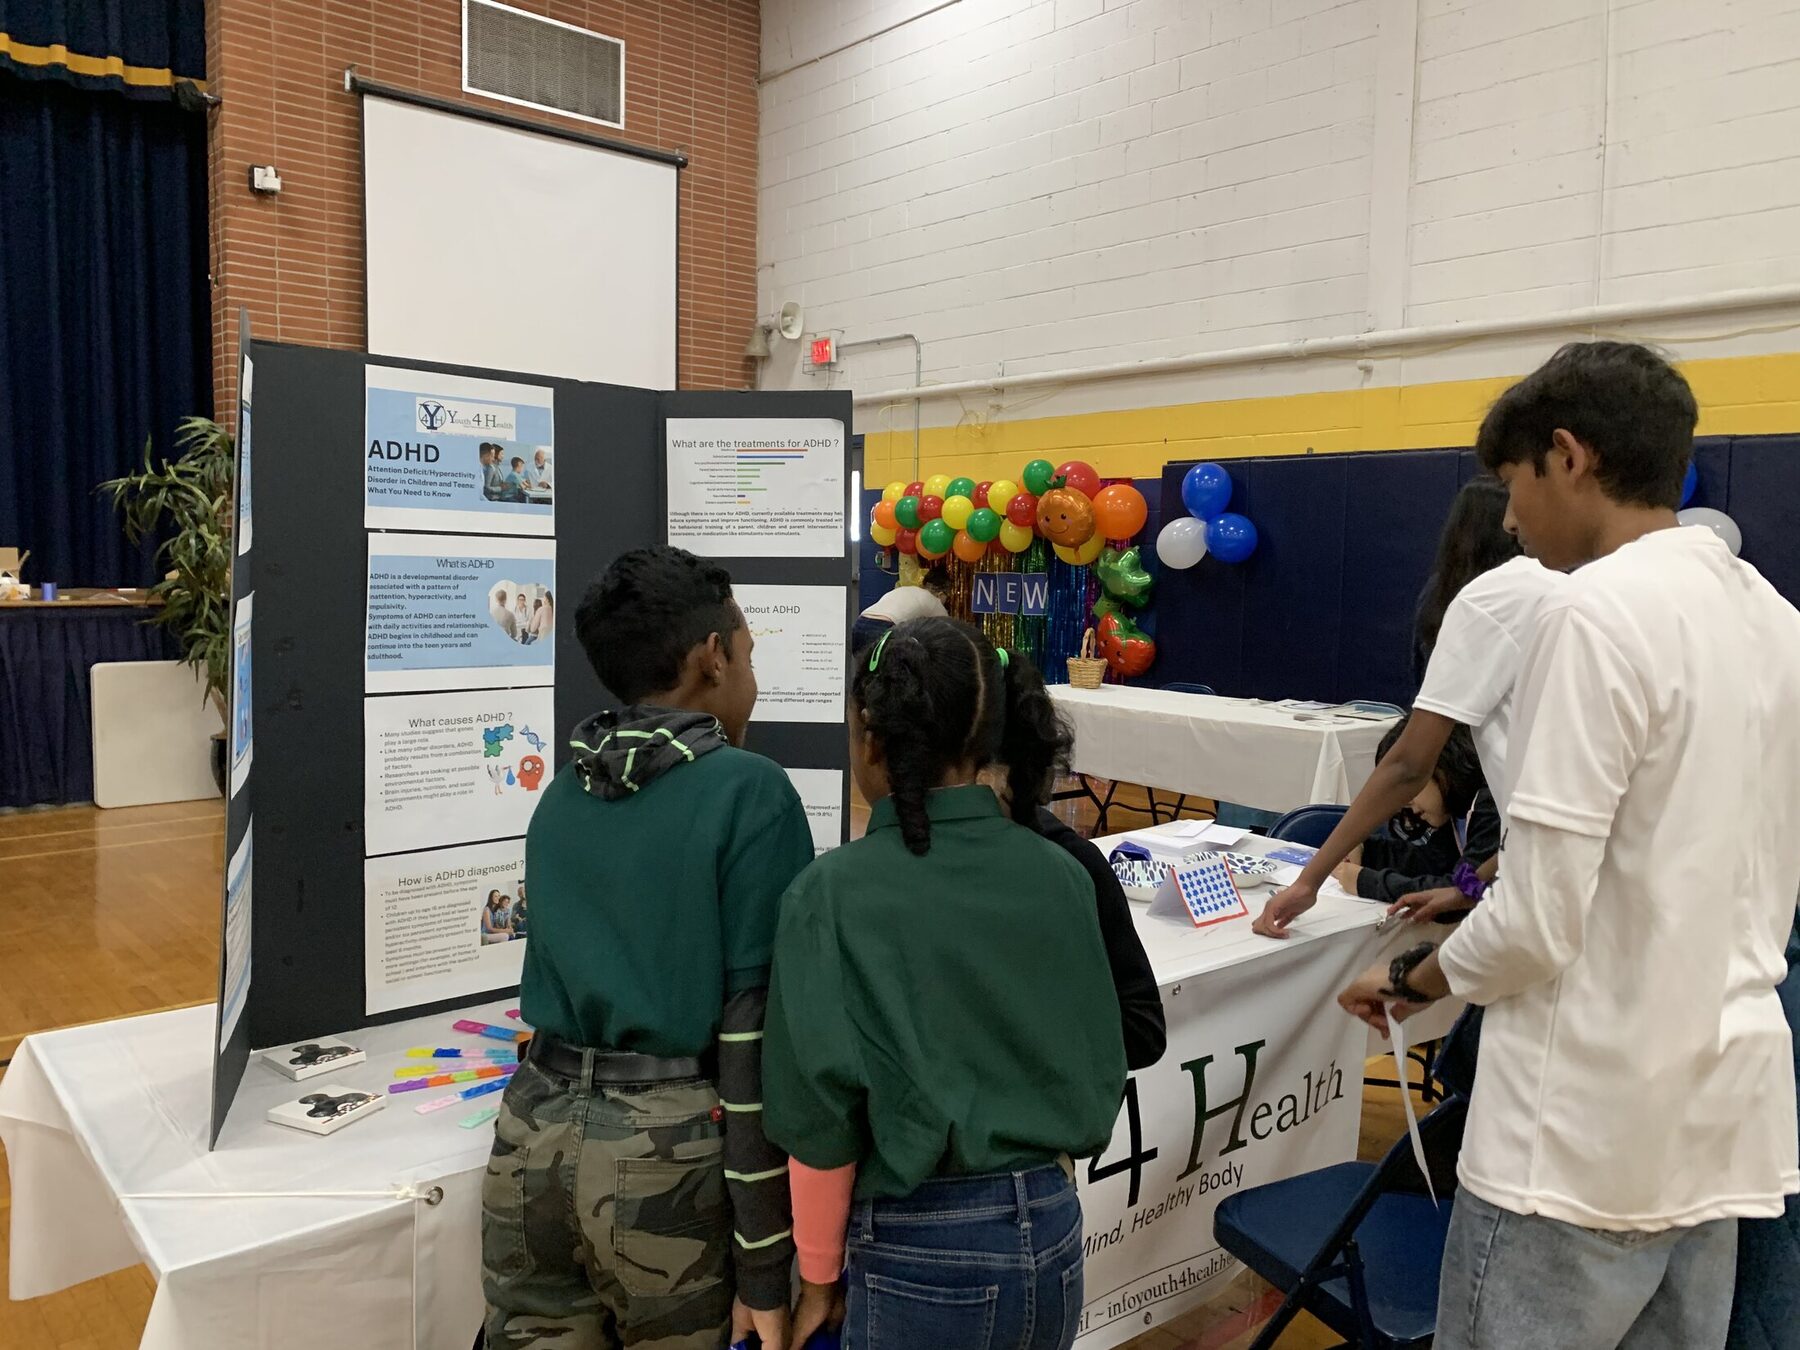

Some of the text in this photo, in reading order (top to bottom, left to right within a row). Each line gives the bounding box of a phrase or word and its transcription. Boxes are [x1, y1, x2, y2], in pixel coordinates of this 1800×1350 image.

[472, 413, 482, 426] 4
[672, 440, 696, 448] What
[717, 440, 731, 448] the
[734, 439, 785, 448] treatments
[788, 439, 800, 448] for
[803, 439, 831, 448] ADHD
[834, 439, 839, 447] ?
[368, 440, 440, 463] ADHD
[368, 465, 476, 479] Attention Deficit/Hyperactivity
[368, 476, 398, 484] Disorder
[408, 478, 437, 487] Children
[436, 559, 494, 569] What is ADHD
[976, 579, 1048, 609] NEW
[743, 605, 801, 614] about ADHD
[408, 712, 513, 728] What causes ADHD ?
[398, 860, 525, 887] How is ADHD diagnosed ?
[1088, 1039, 1343, 1208] 4 Health
[1131, 1184, 1195, 1233] Healthy
[1199, 1161, 1244, 1195] Body
